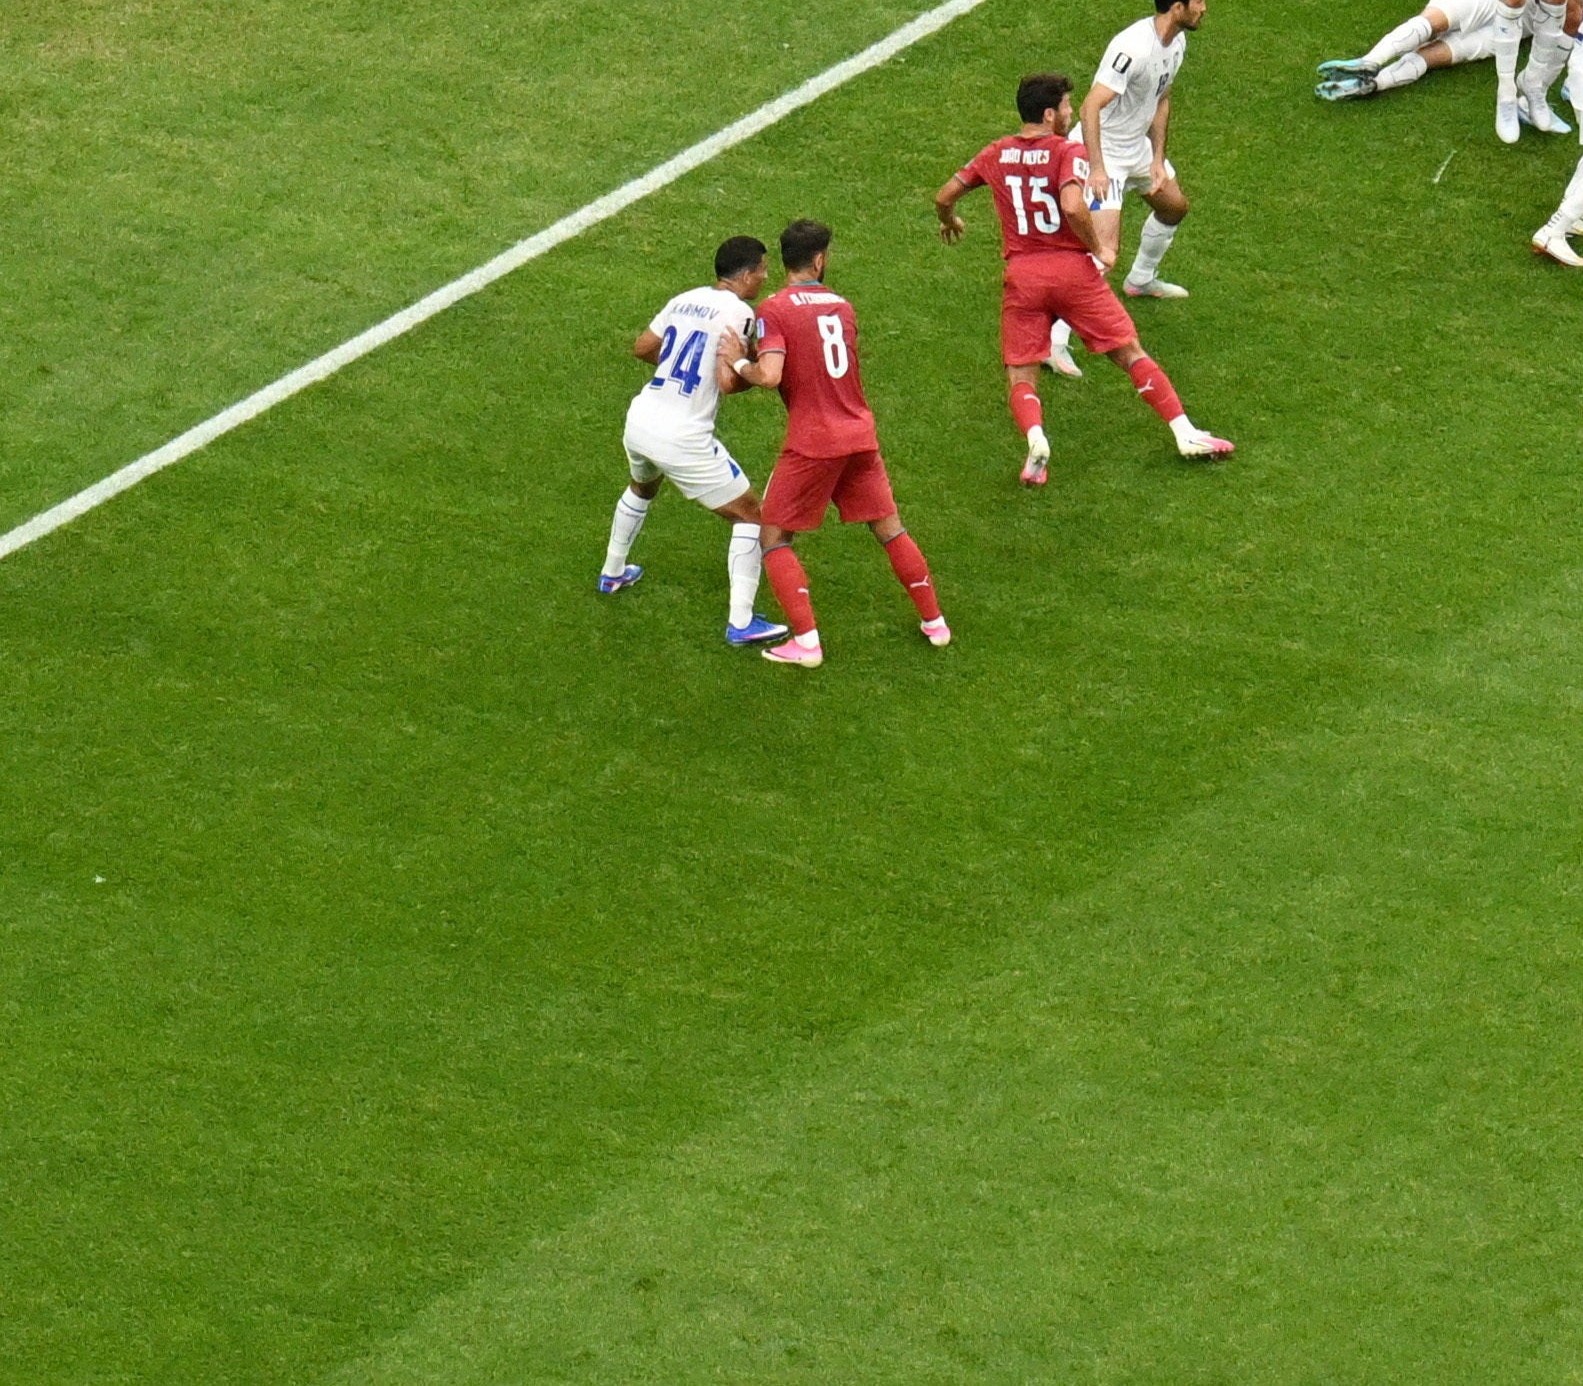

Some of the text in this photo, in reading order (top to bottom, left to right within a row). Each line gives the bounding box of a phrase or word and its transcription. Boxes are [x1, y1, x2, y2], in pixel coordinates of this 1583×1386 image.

[1004, 174, 1061, 236] 15
[672, 302, 720, 320] KARIMOV
[651, 324, 708, 397] 24
[816, 313, 849, 379] 8
